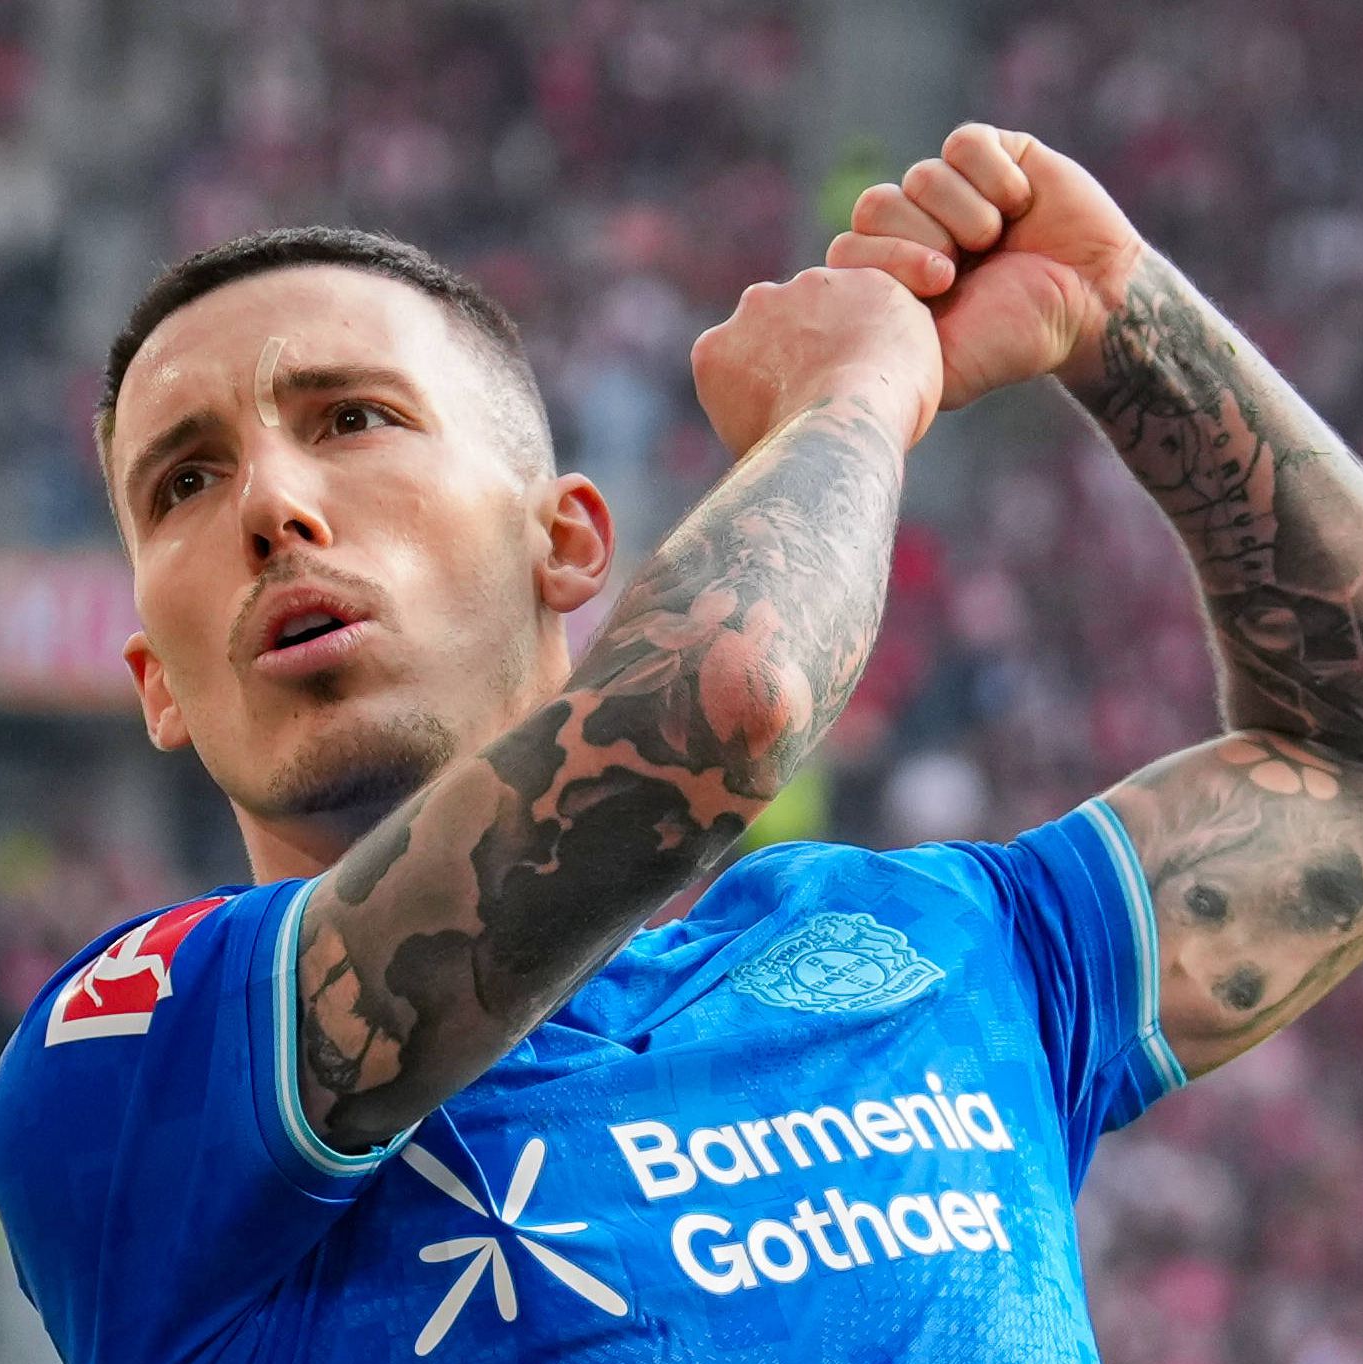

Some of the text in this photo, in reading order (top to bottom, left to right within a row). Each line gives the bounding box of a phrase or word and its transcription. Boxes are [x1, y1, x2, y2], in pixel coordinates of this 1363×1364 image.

[812, 957, 871, 990] BAYER
[610, 1072, 1014, 1200] Barmenia
[672, 1188, 1014, 1295] Gothaer
